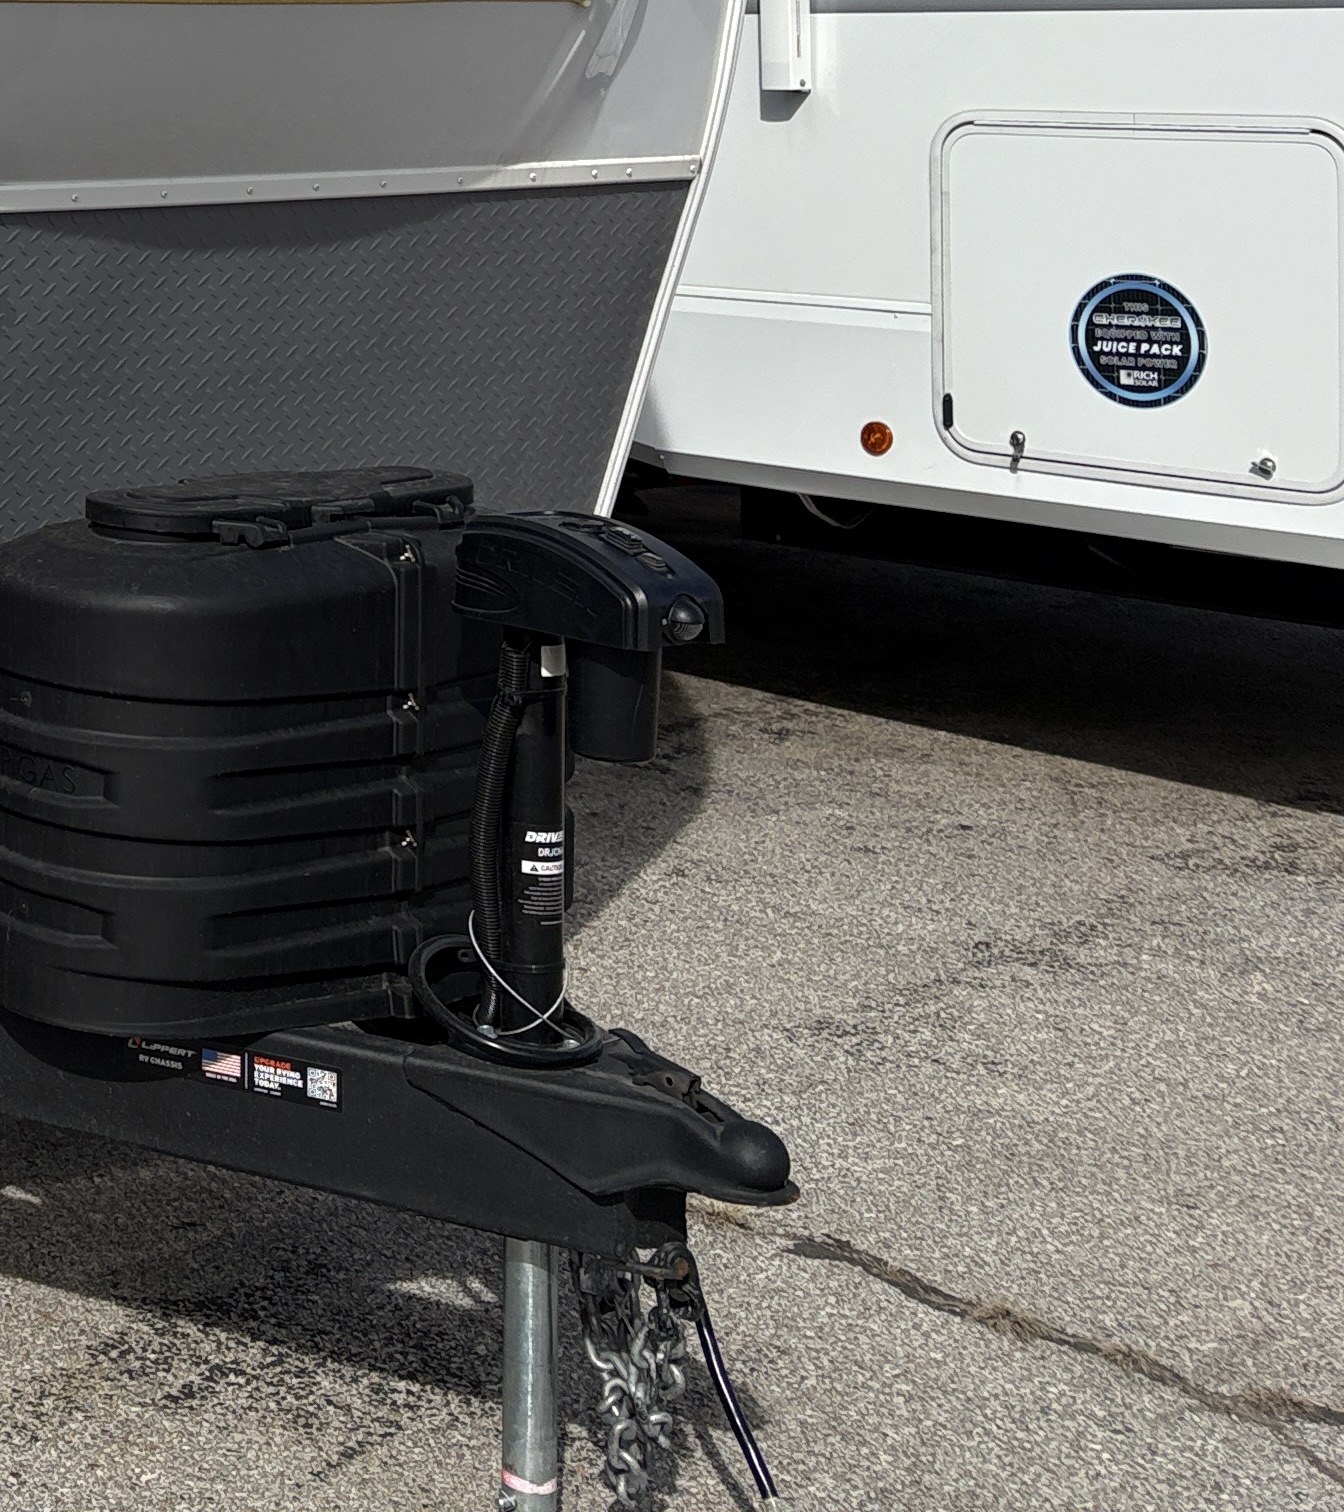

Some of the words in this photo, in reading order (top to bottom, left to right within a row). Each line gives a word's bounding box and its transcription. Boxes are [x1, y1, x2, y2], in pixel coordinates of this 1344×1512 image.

[1092, 340, 1138, 354] JUICE
[1139, 342, 1184, 356] PACK
[1099, 355, 1136, 367] SOLAR
[1137, 357, 1178, 369] POWER
[1133, 370, 1159, 380] RICH
[18, 754, 76, 795] GAS
[253, 1071, 304, 1088] EXPERIENCE
